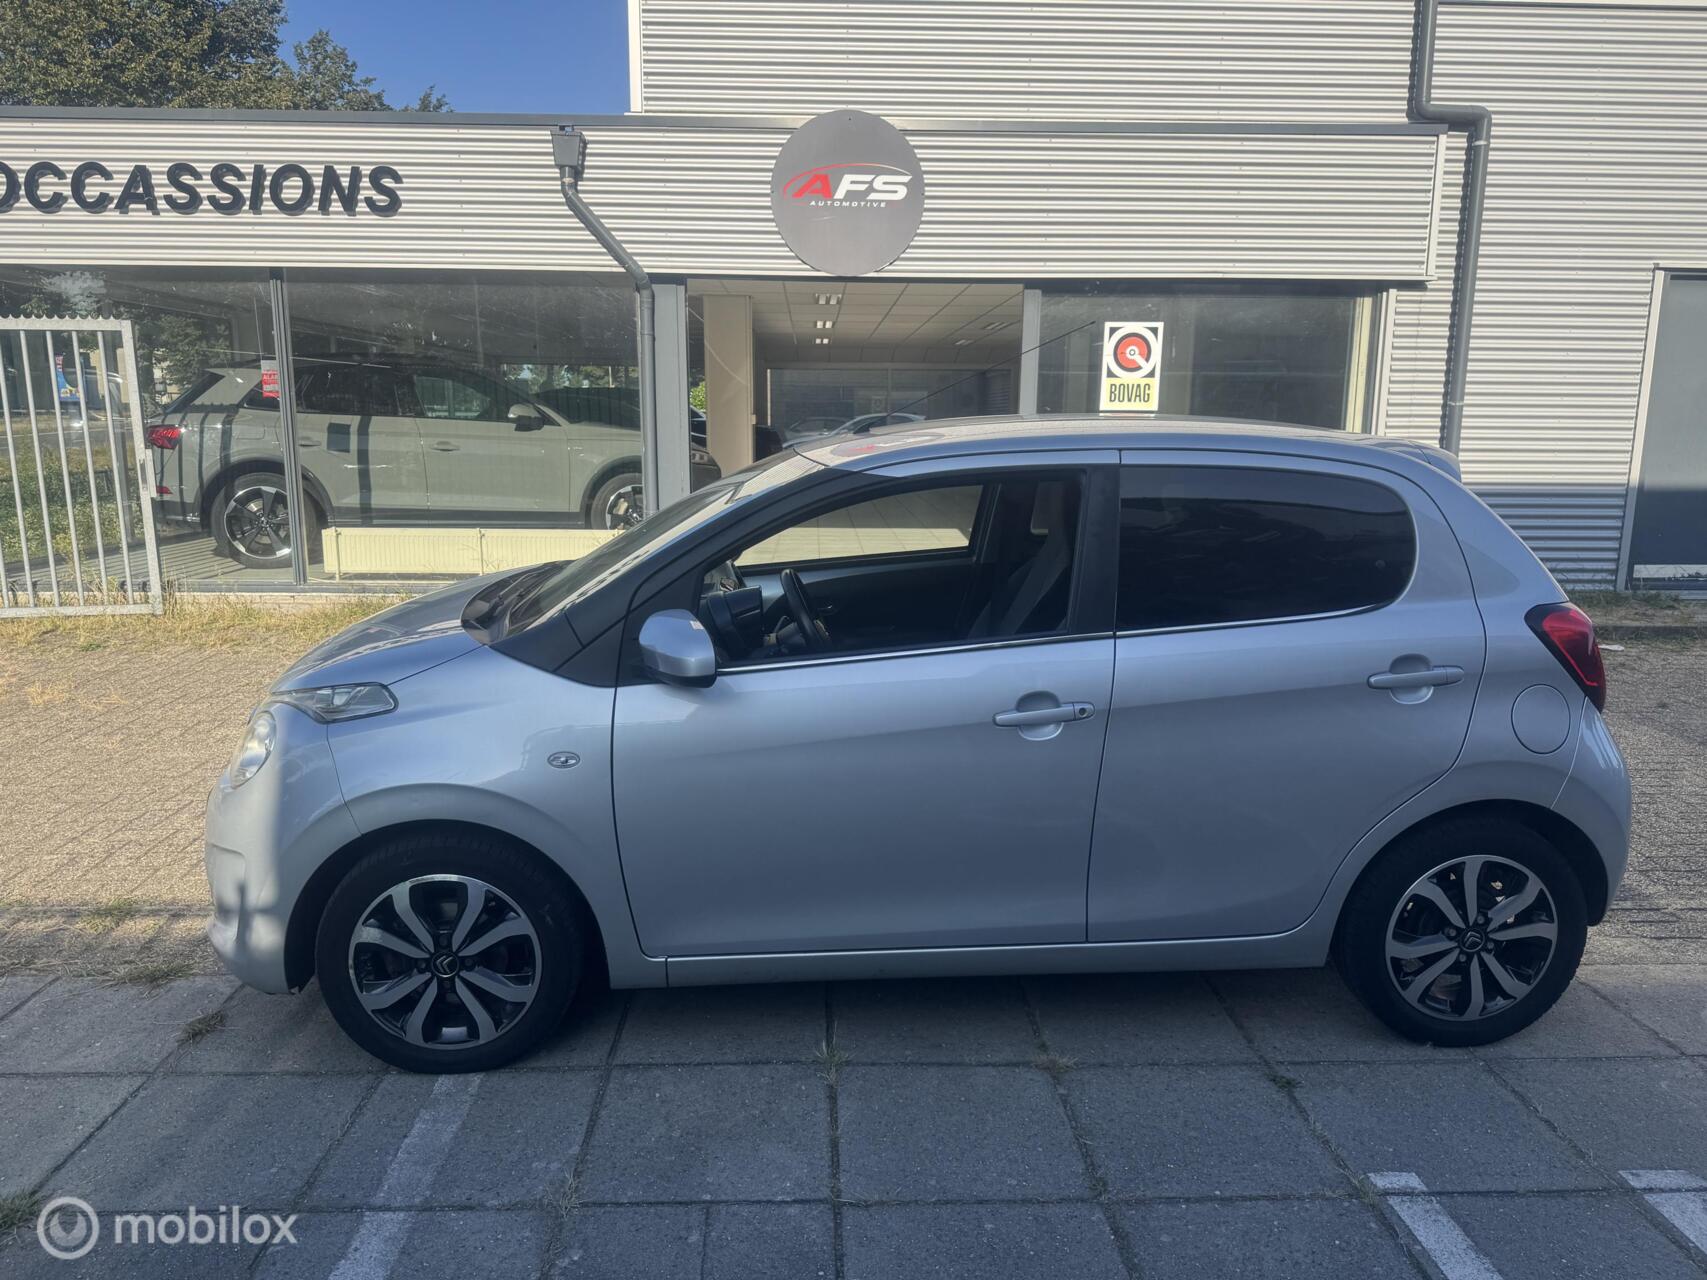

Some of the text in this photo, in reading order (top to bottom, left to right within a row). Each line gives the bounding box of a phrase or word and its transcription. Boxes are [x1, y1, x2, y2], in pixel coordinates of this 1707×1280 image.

[791, 174, 913, 200] AFS
[809, 200, 887, 208] AUTOMOTIVE
[1109, 383, 1152, 403] BOVAG
